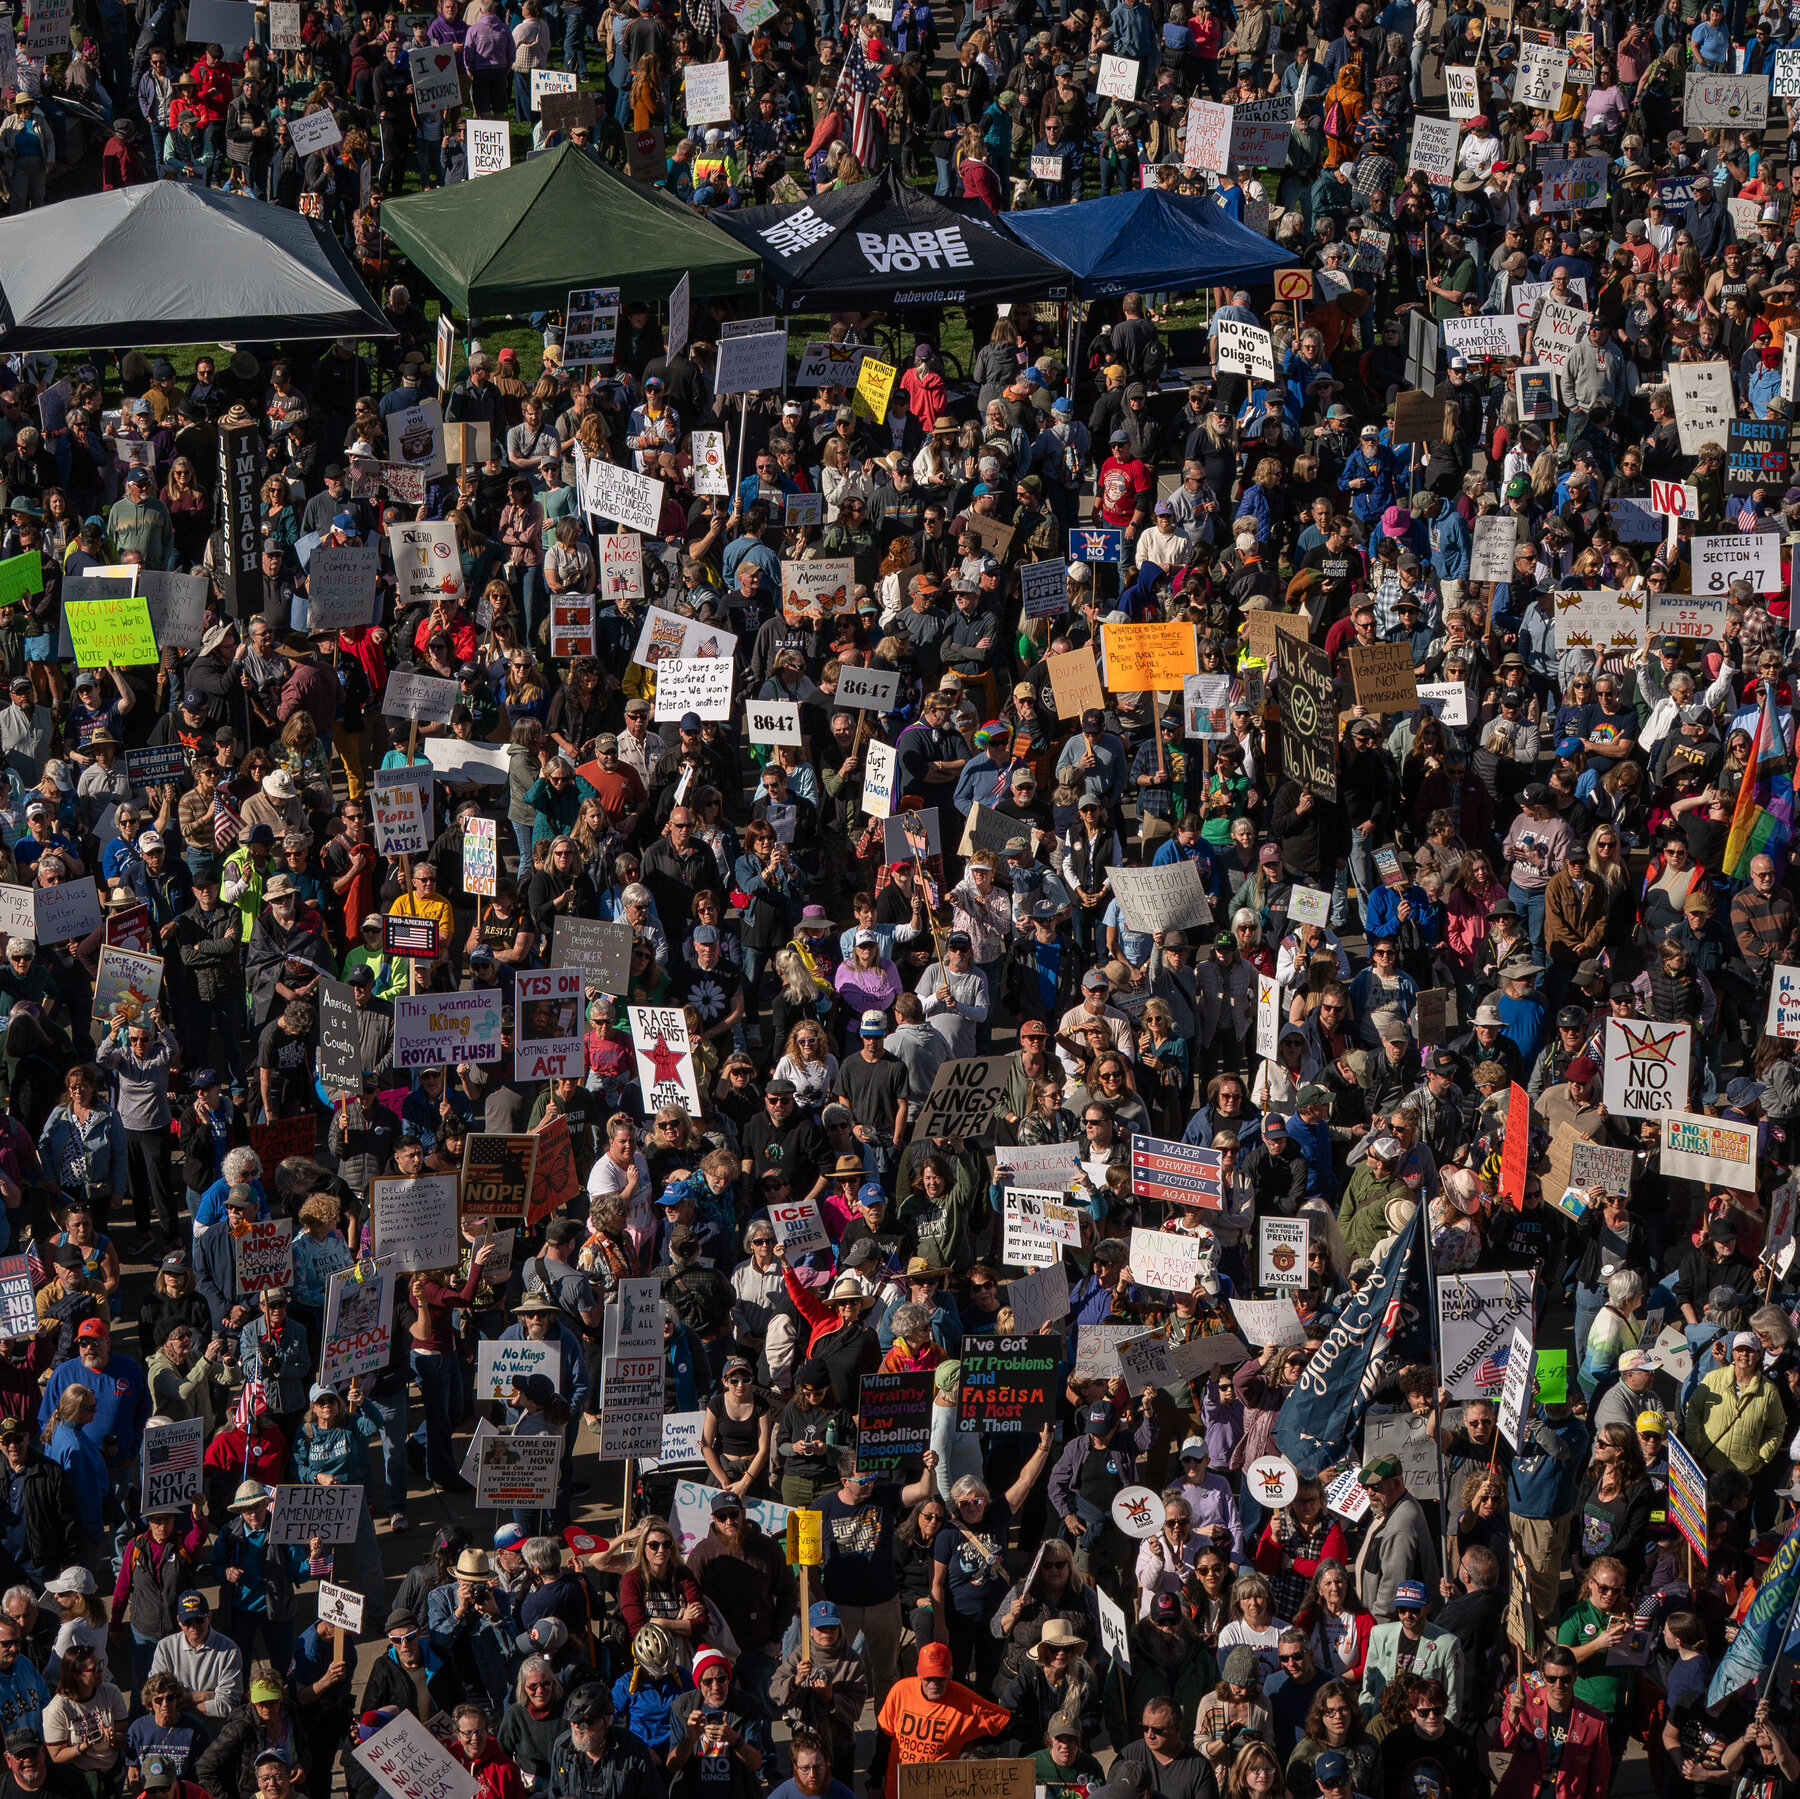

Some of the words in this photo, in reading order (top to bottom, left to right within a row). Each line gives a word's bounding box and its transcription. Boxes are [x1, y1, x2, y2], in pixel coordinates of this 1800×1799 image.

[30, 7, 70, 22] AMERICA
[39, 22, 59, 32] NOT
[27, 34, 67, 49] FACISTS
[418, 58, 430, 74] I
[1109, 59, 1128, 75] NO
[539, 72, 552, 84] WE
[556, 72, 570, 84] THE
[1448, 75, 1463, 90] NO
[416, 83, 459, 104] DEMOCRACY
[544, 83, 567, 93] PEOPLE
[1101, 77, 1133, 98] KINGS
[1450, 91, 1474, 108] KING
[293, 113, 332, 133] CONGRESS
[1420, 122, 1450, 136] IMAGINE
[474, 130, 503, 144] FIGHT
[1421, 132, 1448, 145] BEING
[475, 143, 504, 158] TRUTH
[475, 155, 503, 169] DECAY
[1414, 153, 1451, 167] DIVERSITY
[1546, 171, 1601, 184] AMERICA
[1554, 180, 1598, 200] KIND
[785, 205, 837, 243] BABE
[758, 223, 814, 257] VOTE
[856, 226, 966, 255] BABE
[863, 248, 974, 273] VOTE
[894, 289, 966, 304] babevote.org
[1545, 304, 1577, 321] ONLY
[1446, 318, 1495, 331] PROTECT
[1483, 327, 1504, 335] OUR
[1553, 319, 1577, 335] YOU
[1220, 321, 1238, 334] NO
[1241, 327, 1269, 345] Kings
[1452, 335, 1506, 345] GRANDKIDS
[1238, 339, 1255, 352] NO
[1461, 344, 1510, 355] FUTURE!!
[1221, 347, 1273, 371] Oligarchs
[862, 359, 875, 371] NO
[875, 362, 895, 378] KINGS
[1731, 423, 1787, 439] LIBERTY
[1742, 438, 1771, 451] AND
[594, 461, 615, 478] THIS
[623, 468, 633, 481] IS
[633, 471, 652, 489] THE
[1728, 468, 1753, 483] FOR
[1756, 468, 1783, 483] ALL
[597, 472, 652, 501] GOVERNMENT
[236, 434, 258, 572] IMPEACH
[594, 484, 612, 501] THE
[612, 490, 653, 515] FOUNDERS
[589, 497, 618, 517] WARNED
[619, 507, 630, 520] US
[628, 510, 656, 527] ABOUT
[607, 535, 637, 549] NO!
[1707, 536, 1750, 548] ARTICLE
[1754, 536, 1764, 546] II
[604, 549, 641, 564] KINGS!
[1087, 546, 1105, 555] NO
[1702, 551, 1749, 563] SECTION
[1752, 550, 1761, 561] 4
[797, 571, 839, 584] MONARCH
[1028, 574, 1062, 586] HANDS
[1029, 584, 1063, 598] OFF!
[66, 600, 123, 618] VAGINAS
[1658, 622, 1714, 636] CRUELTY
[92, 633, 135, 648] VAGINAS
[1359, 646, 1403, 664] FIGHT
[1056, 662, 1085, 680] DUMP
[1278, 640, 1295, 676] No
[1299, 648, 1334, 701] Kings
[1355, 659, 1414, 677] IGNORANCE
[1375, 674, 1400, 688] NOT
[1058, 683, 1095, 702] TRUMP
[1358, 687, 1415, 706] IMMIGRANTS
[753, 714, 794, 731] 8647
[1283, 735, 1300, 776] No
[1302, 744, 1336, 789] Nazis
[377, 810, 415, 825] PEOPLE
[383, 836, 422, 853] ABIDE
[388, 916, 434, 927] PRO-AMERICA
[485, 926, 513, 937] RESIST
[388, 946, 435, 957] ANTI-TRUMP
[518, 978, 551, 995] YES
[558, 977, 580, 991] ON
[323, 988, 352, 1014] America
[400, 1000, 426, 1016] This
[438, 999, 492, 1012] wannabe
[331, 1016, 339, 1026] is
[342, 1019, 347, 1027] a
[430, 1013, 470, 1035] King
[638, 1010, 677, 1027] RAGE
[323, 1033, 354, 1059] Country
[518, 1045, 550, 1056] VOTING
[553, 1042, 580, 1055] RIGHTS
[338, 1054, 346, 1066] of
[402, 1048, 449, 1065] ROYAL
[452, 1045, 496, 1062] FLUSH
[532, 1055, 565, 1076] ACT
[321, 1064, 359, 1089] Immigrants
[948, 1062, 989, 1086] NO
[1628, 1061, 1669, 1090] NO
[658, 1083, 679, 1095] THE
[926, 1087, 997, 1111] KINGS
[1622, 1087, 1672, 1112] KINGS
[925, 1114, 985, 1138] EVER
[1162, 1144, 1200, 1159] MAKE
[1156, 1158, 1207, 1176] ORWELL
[1157, 1173, 1207, 1190] FICTION
[466, 1184, 525, 1202] NOPE
[1162, 1189, 1201, 1204] AGAIN
[466, 1204, 493, 1212] SINCE
[496, 1204, 518, 1214] 1776
[773, 1205, 815, 1222] ICE
[784, 1218, 809, 1231] OUT
[1267, 1222, 1302, 1231] REMEMBER
[783, 1231, 822, 1248] CITIES
[1266, 1234, 1303, 1243] PREVENT
[1, 1278, 30, 1291] WAR
[1264, 1272, 1303, 1282] FASCISM
[1442, 1310, 1469, 1321] FOR
[965, 1338, 995, 1352] I've
[1000, 1338, 1027, 1352] Got
[1444, 1296, 1532, 1387] INSURRECTION
[502, 1348, 517, 1359] No
[520, 1348, 545, 1364] Kings
[963, 1358, 983, 1370] 47
[986, 1356, 1054, 1371] Problems
[493, 1361, 508, 1372] No
[510, 1362, 533, 1374] Wars
[623, 1363, 655, 1377] STOP
[967, 1371, 996, 1385] and
[604, 1412, 661, 1423] DEMOCRACY
[963, 1404, 977, 1417] Is
[985, 1403, 1022, 1418] Most
[622, 1426, 642, 1436] NOT
[960, 1419, 978, 1431] of
[982, 1418, 1022, 1432] Them
[860, 1427, 930, 1443] Rebellion
[512, 1440, 537, 1448] COME
[540, 1440, 556, 1448] ON
[605, 1438, 659, 1450] OLIGARCHY
[522, 1448, 555, 1456] PEOPLE
[148, 1474, 186, 1490] NOT
[190, 1474, 196, 1483] a
[1265, 1483, 1282, 1494] NO
[147, 1488, 195, 1507] KING
[288, 1488, 347, 1505] FIRST
[276, 1508, 354, 1521] AMENDMENT
[1133, 1511, 1152, 1524] NO
[284, 1522, 344, 1540] FIRST
[322, 1584, 340, 1597] RESIST
[340, 1590, 361, 1604] FASCISM
[901, 1714, 945, 1743] DUE
[900, 1738, 944, 1756] PROCESS
